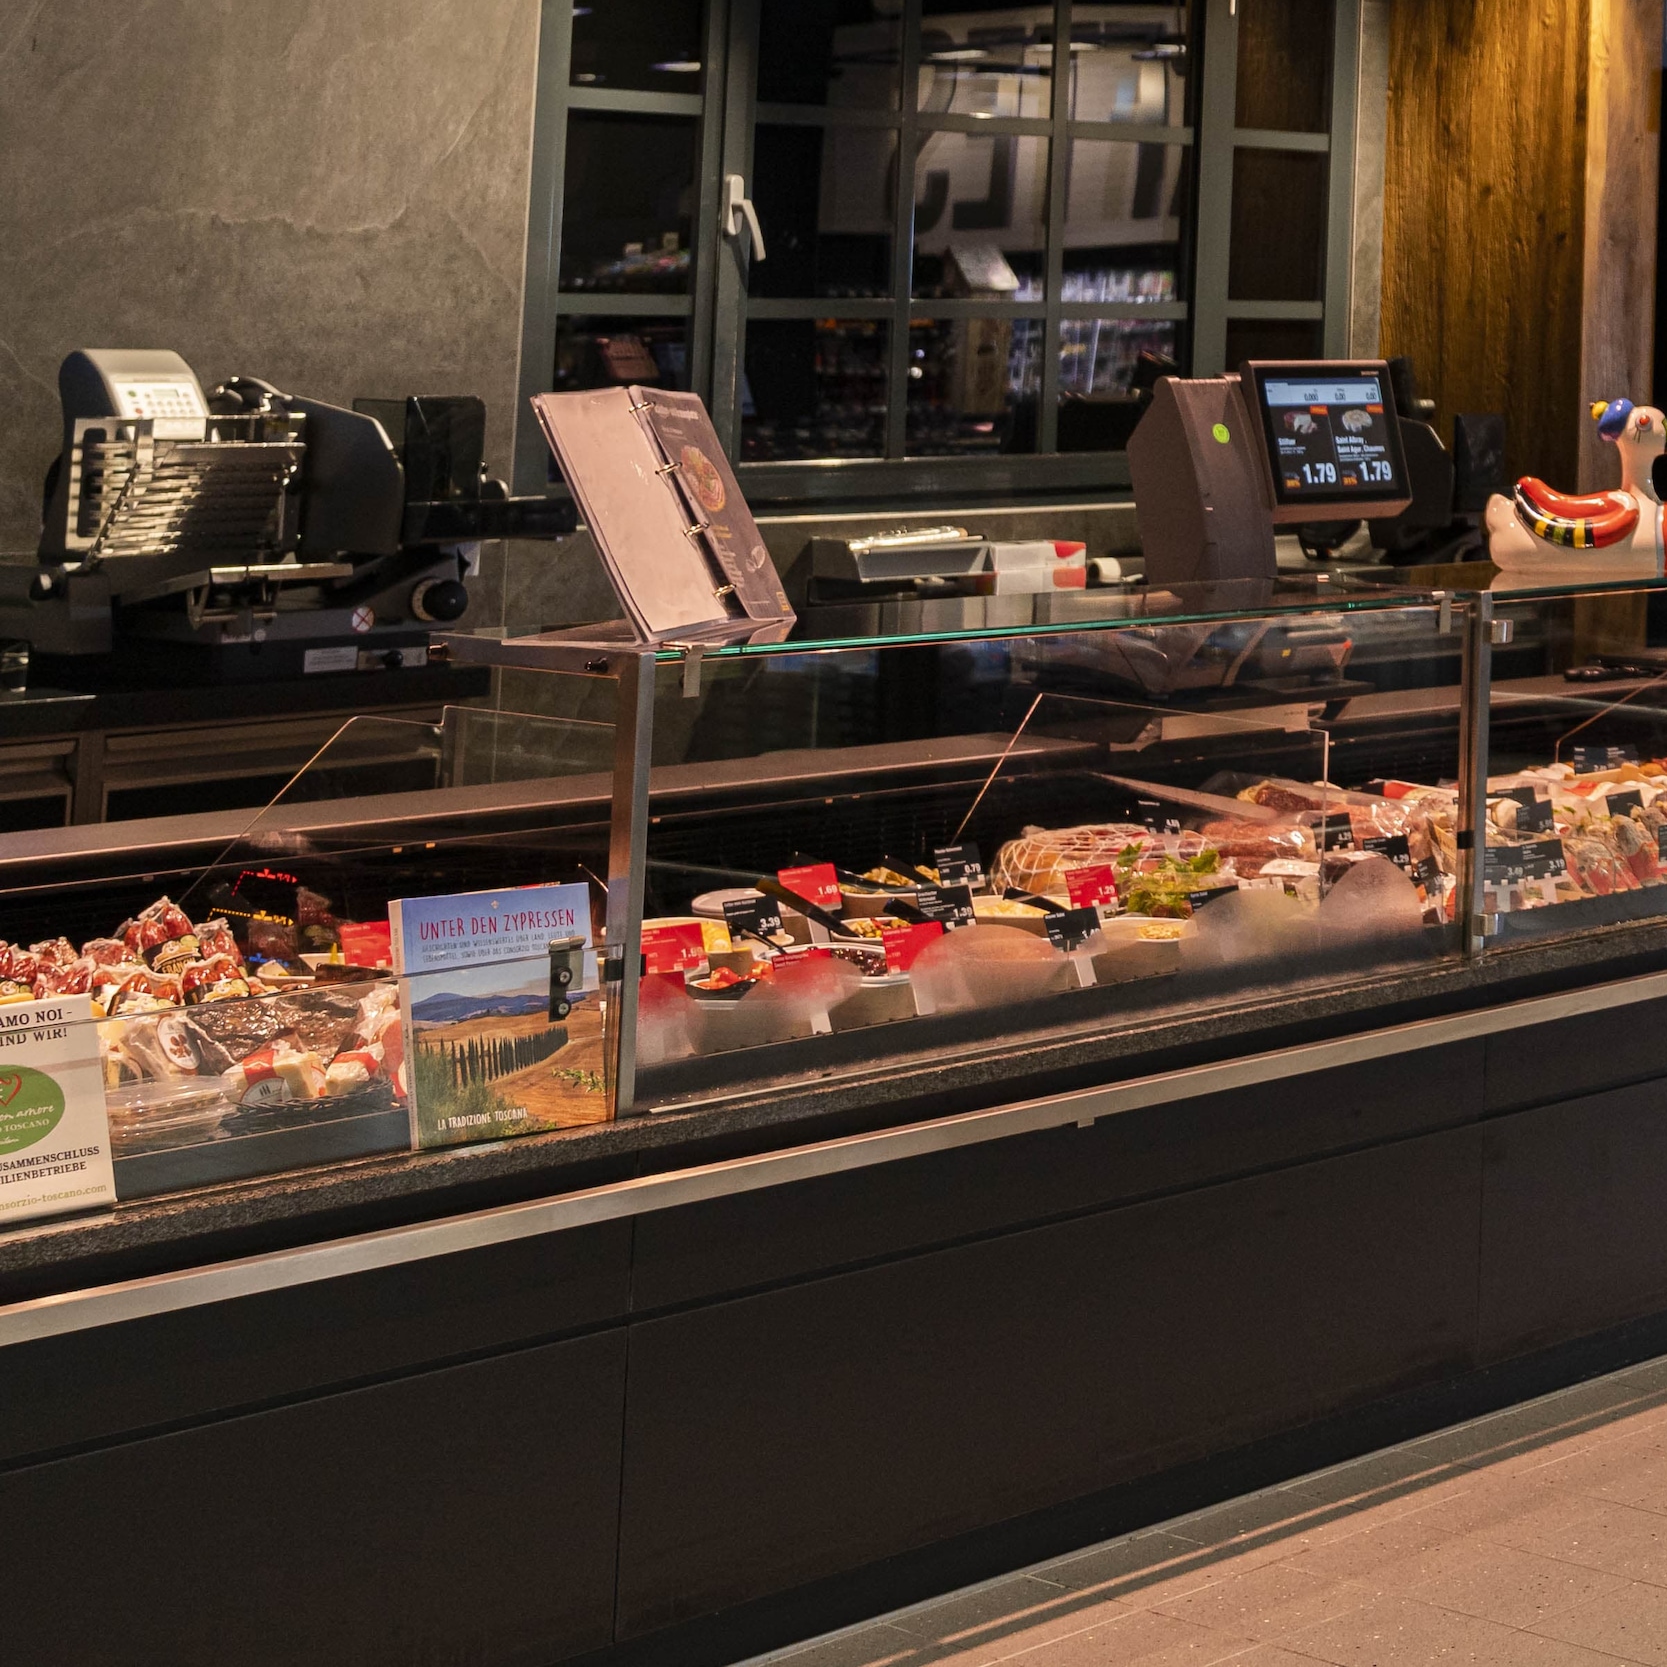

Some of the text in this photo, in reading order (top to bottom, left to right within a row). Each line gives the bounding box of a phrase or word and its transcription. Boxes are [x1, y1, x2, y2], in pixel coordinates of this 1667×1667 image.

[1302, 462, 1337, 484] 1.79
[1359, 460, 1393, 482] 1.79
[419, 908, 576, 942] UNTER DEN ZYPRESSEN
[760, 916, 781, 928] 3.39
[36, 1008, 63, 1023] NOI
[33, 1027, 68, 1042] WIR!
[16, 1105, 55, 1117] amore
[4, 1118, 50, 1132] TOSCANO
[437, 1107, 528, 1131] LA TRADIZIONE TOSCANA
